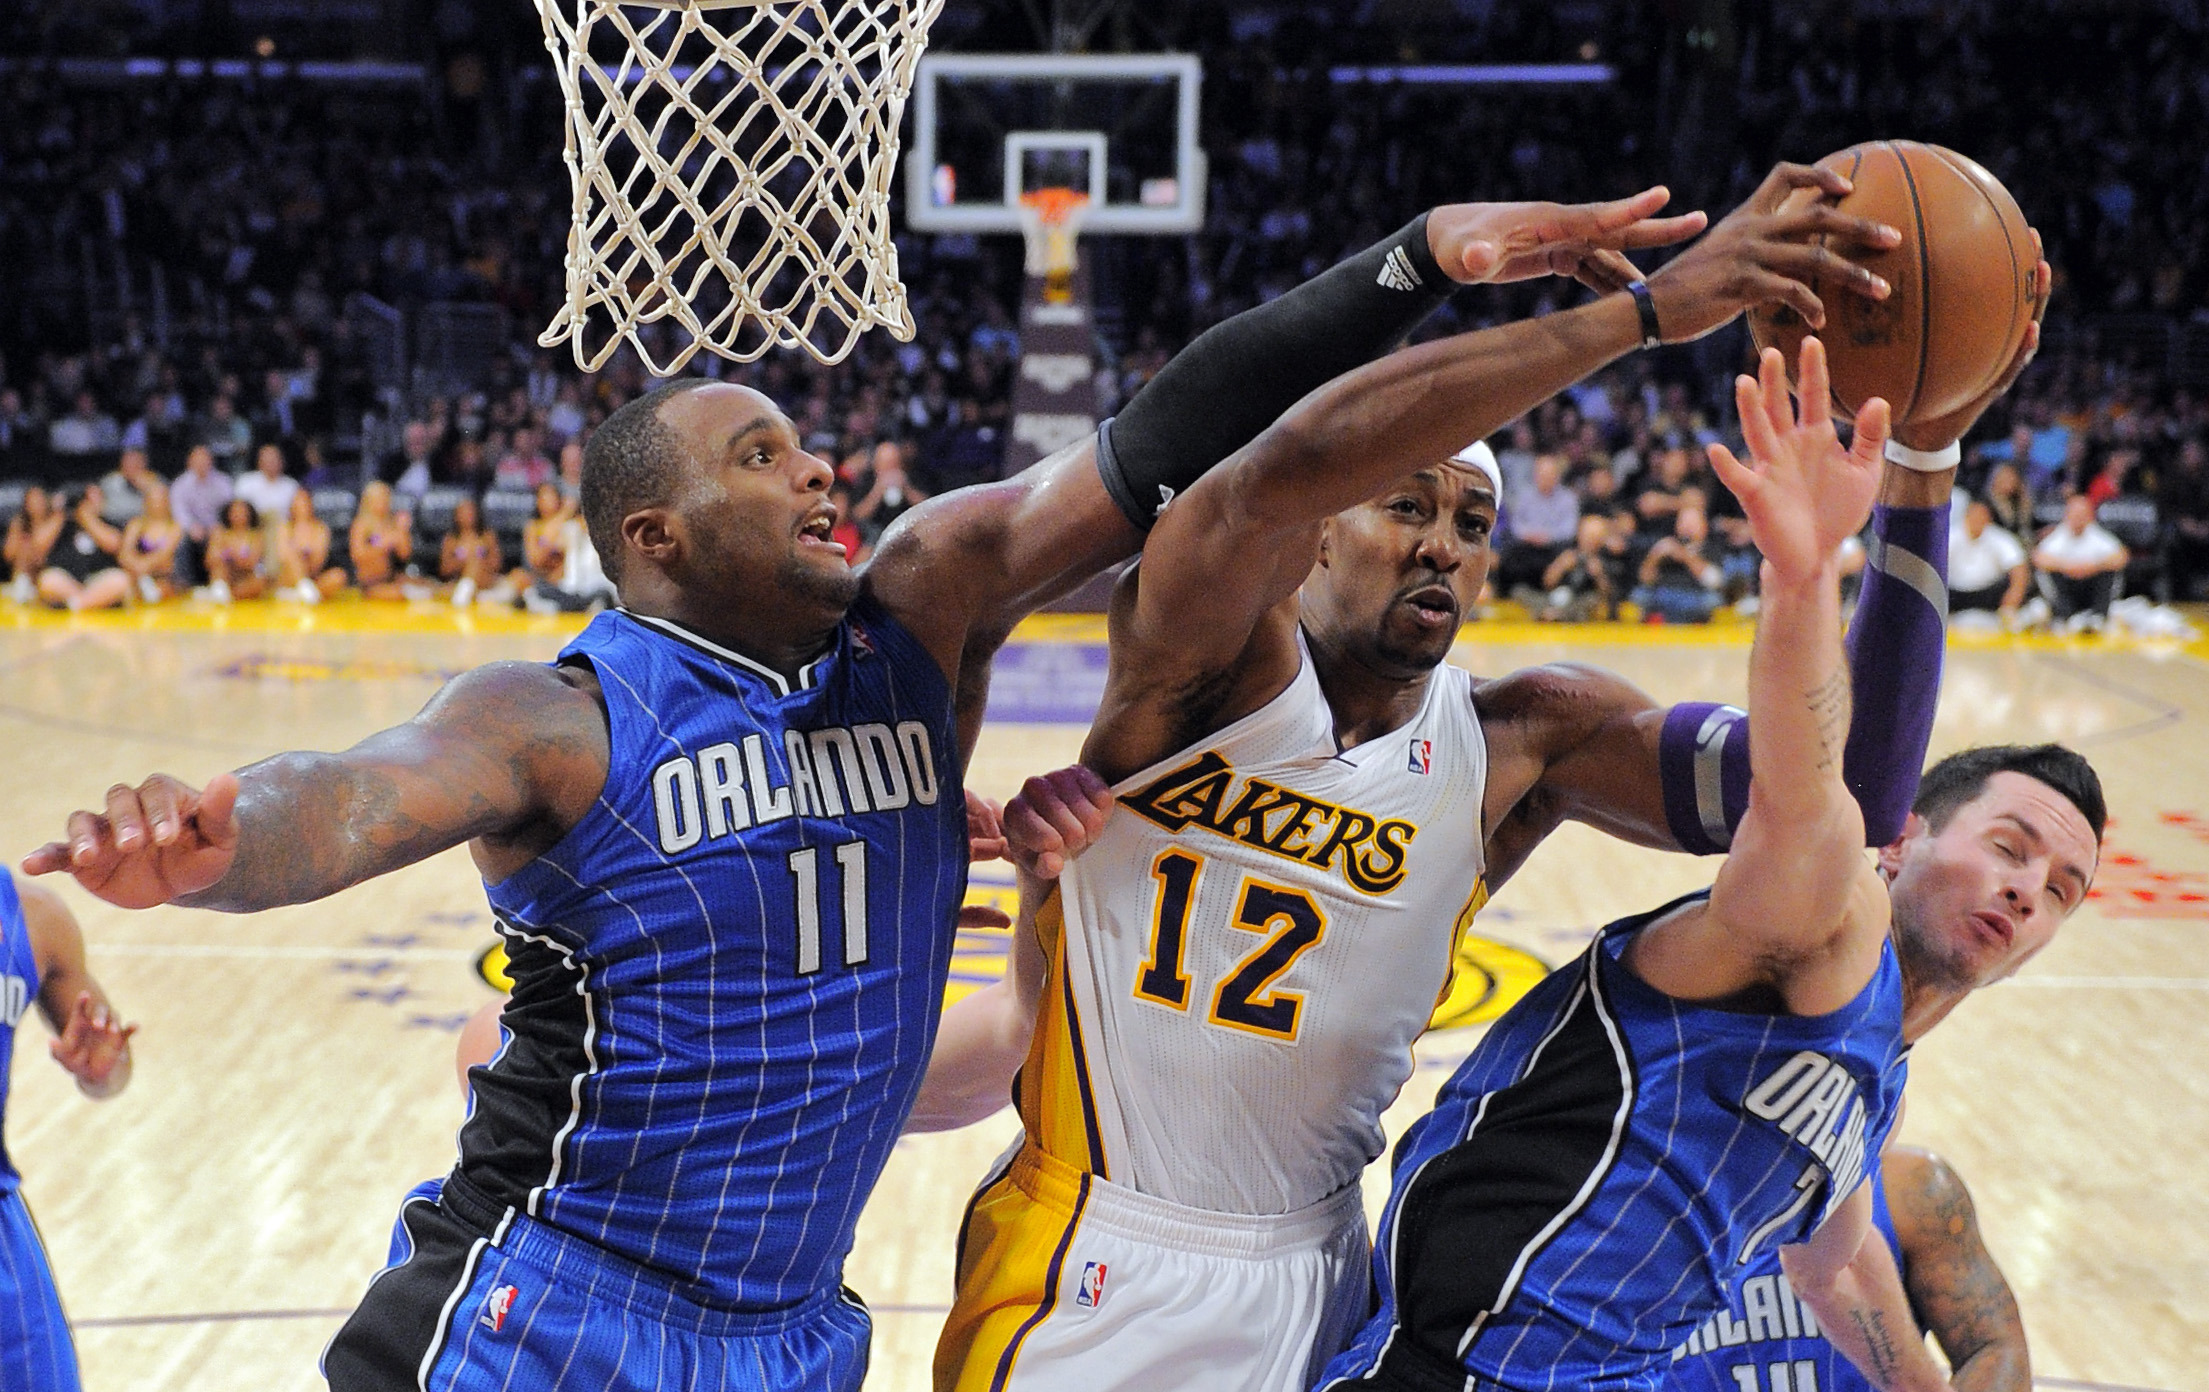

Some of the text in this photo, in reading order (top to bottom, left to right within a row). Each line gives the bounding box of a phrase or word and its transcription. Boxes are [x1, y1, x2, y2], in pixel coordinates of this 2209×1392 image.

[653, 721, 938, 854] ORLANDO
[1114, 750, 1418, 896] LAKERS
[789, 841, 868, 974] 11
[1134, 845, 1328, 1041] 12
